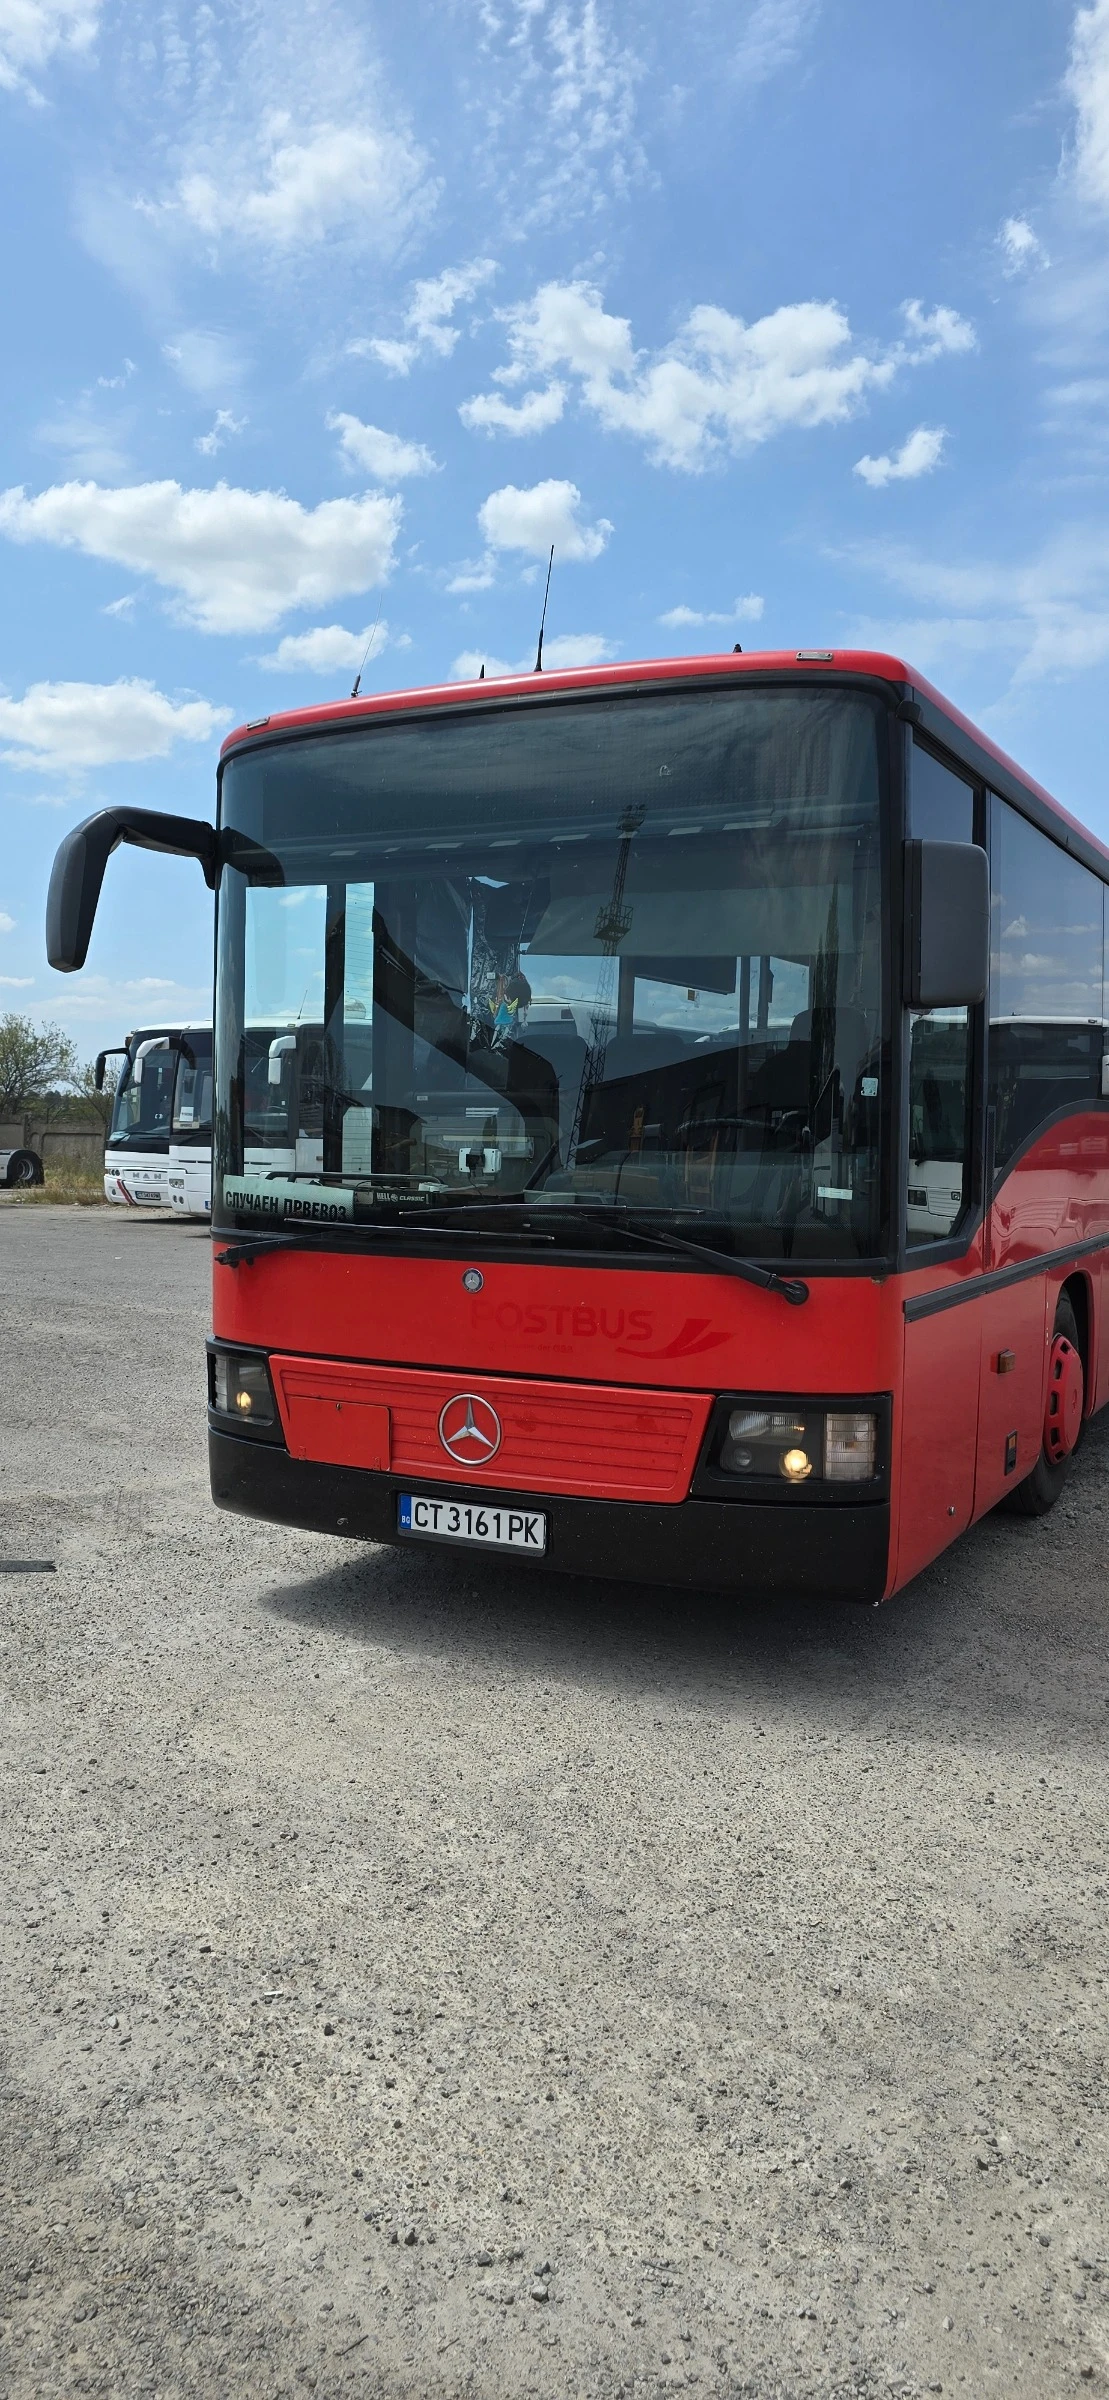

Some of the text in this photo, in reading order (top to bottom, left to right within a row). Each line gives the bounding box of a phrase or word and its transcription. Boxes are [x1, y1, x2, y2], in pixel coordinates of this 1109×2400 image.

[226, 1191, 279, 1213] СЛУЧАЕН
[471, 1300, 656, 1341] POSTBUS
[401, 1515, 411, 1524] BG
[414, 1501, 539, 1545] CT 3161 PK
